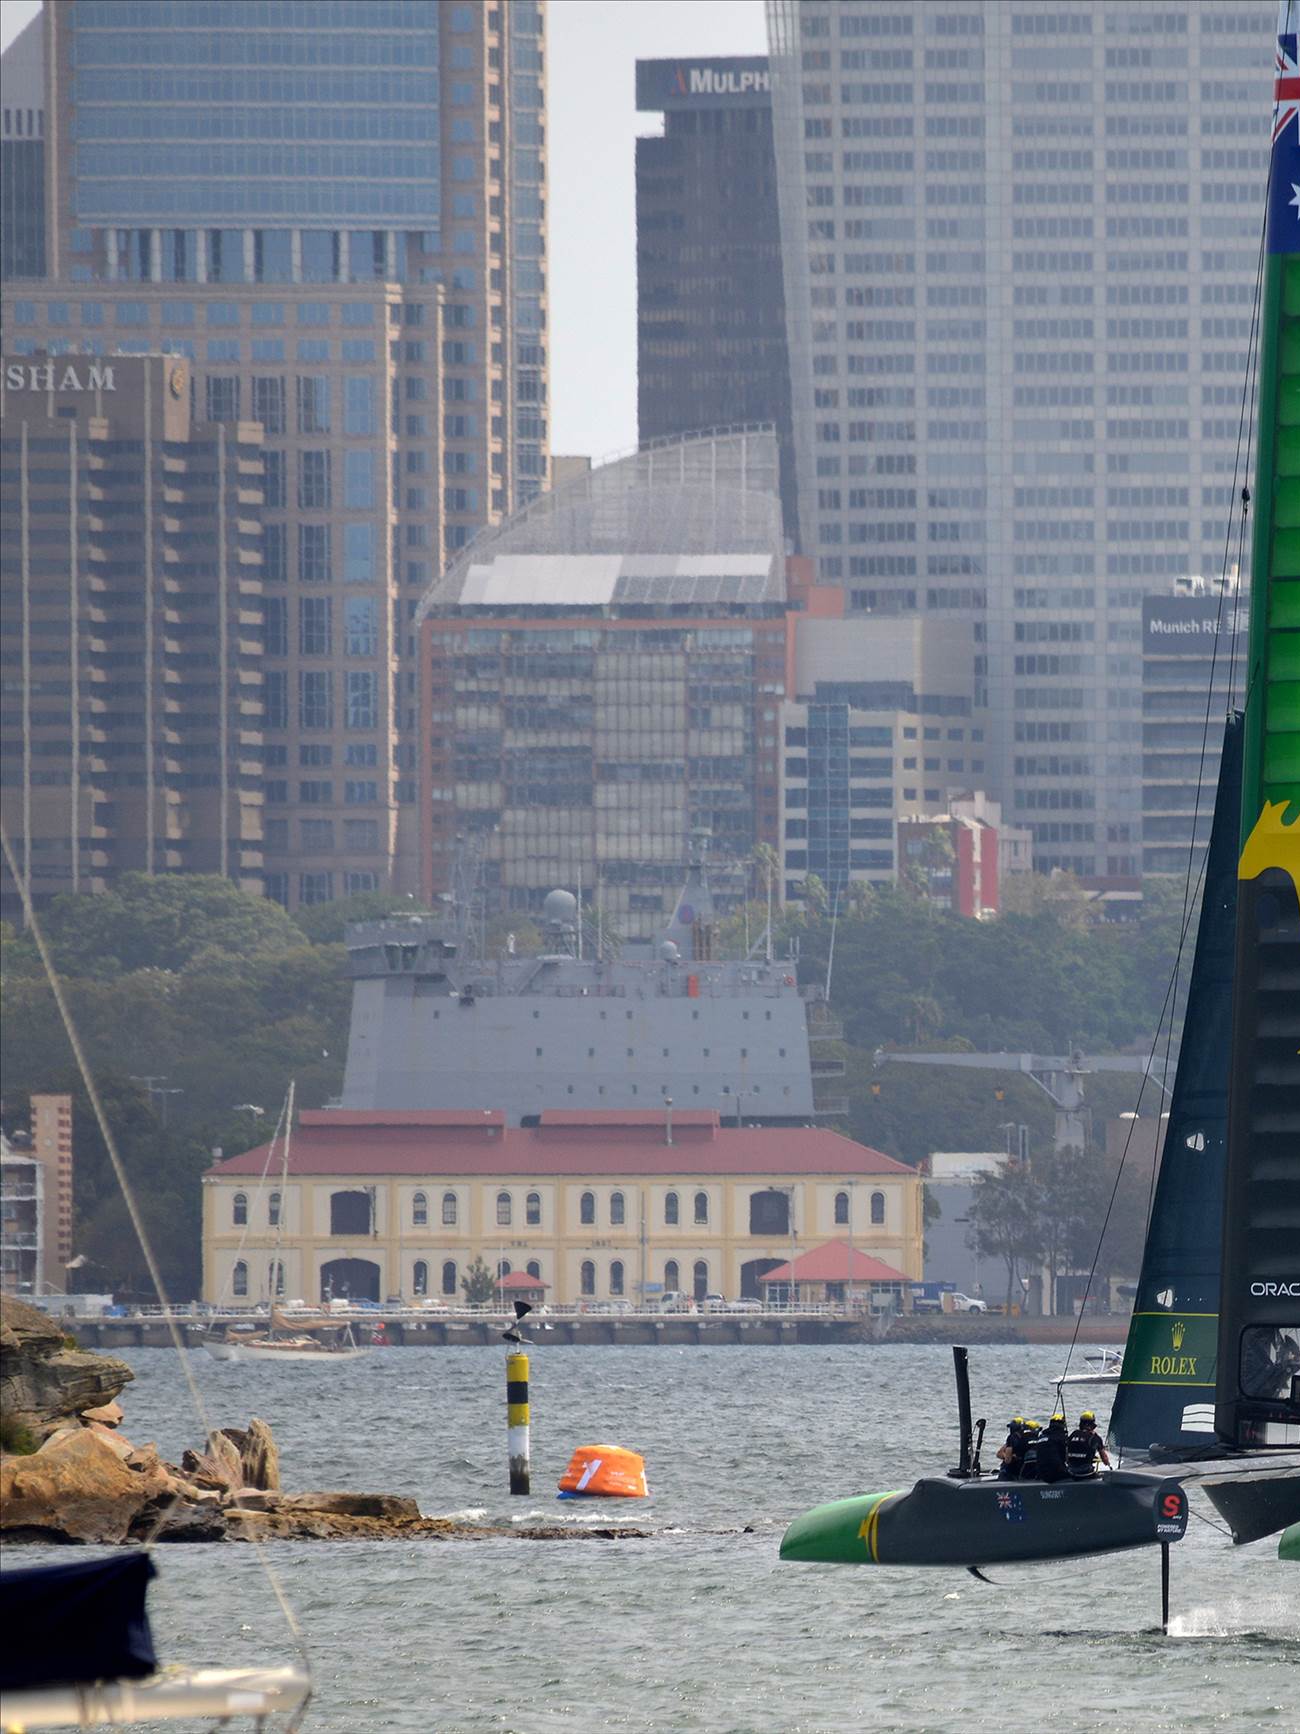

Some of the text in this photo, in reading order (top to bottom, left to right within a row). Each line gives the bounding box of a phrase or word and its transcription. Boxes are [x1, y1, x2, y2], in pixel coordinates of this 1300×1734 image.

[690, 69, 774, 93] MULPH
[6, 364, 117, 391] SHAM
[1150, 619, 1200, 634] Munich
[1150, 1356, 1197, 1375] ROLEX
